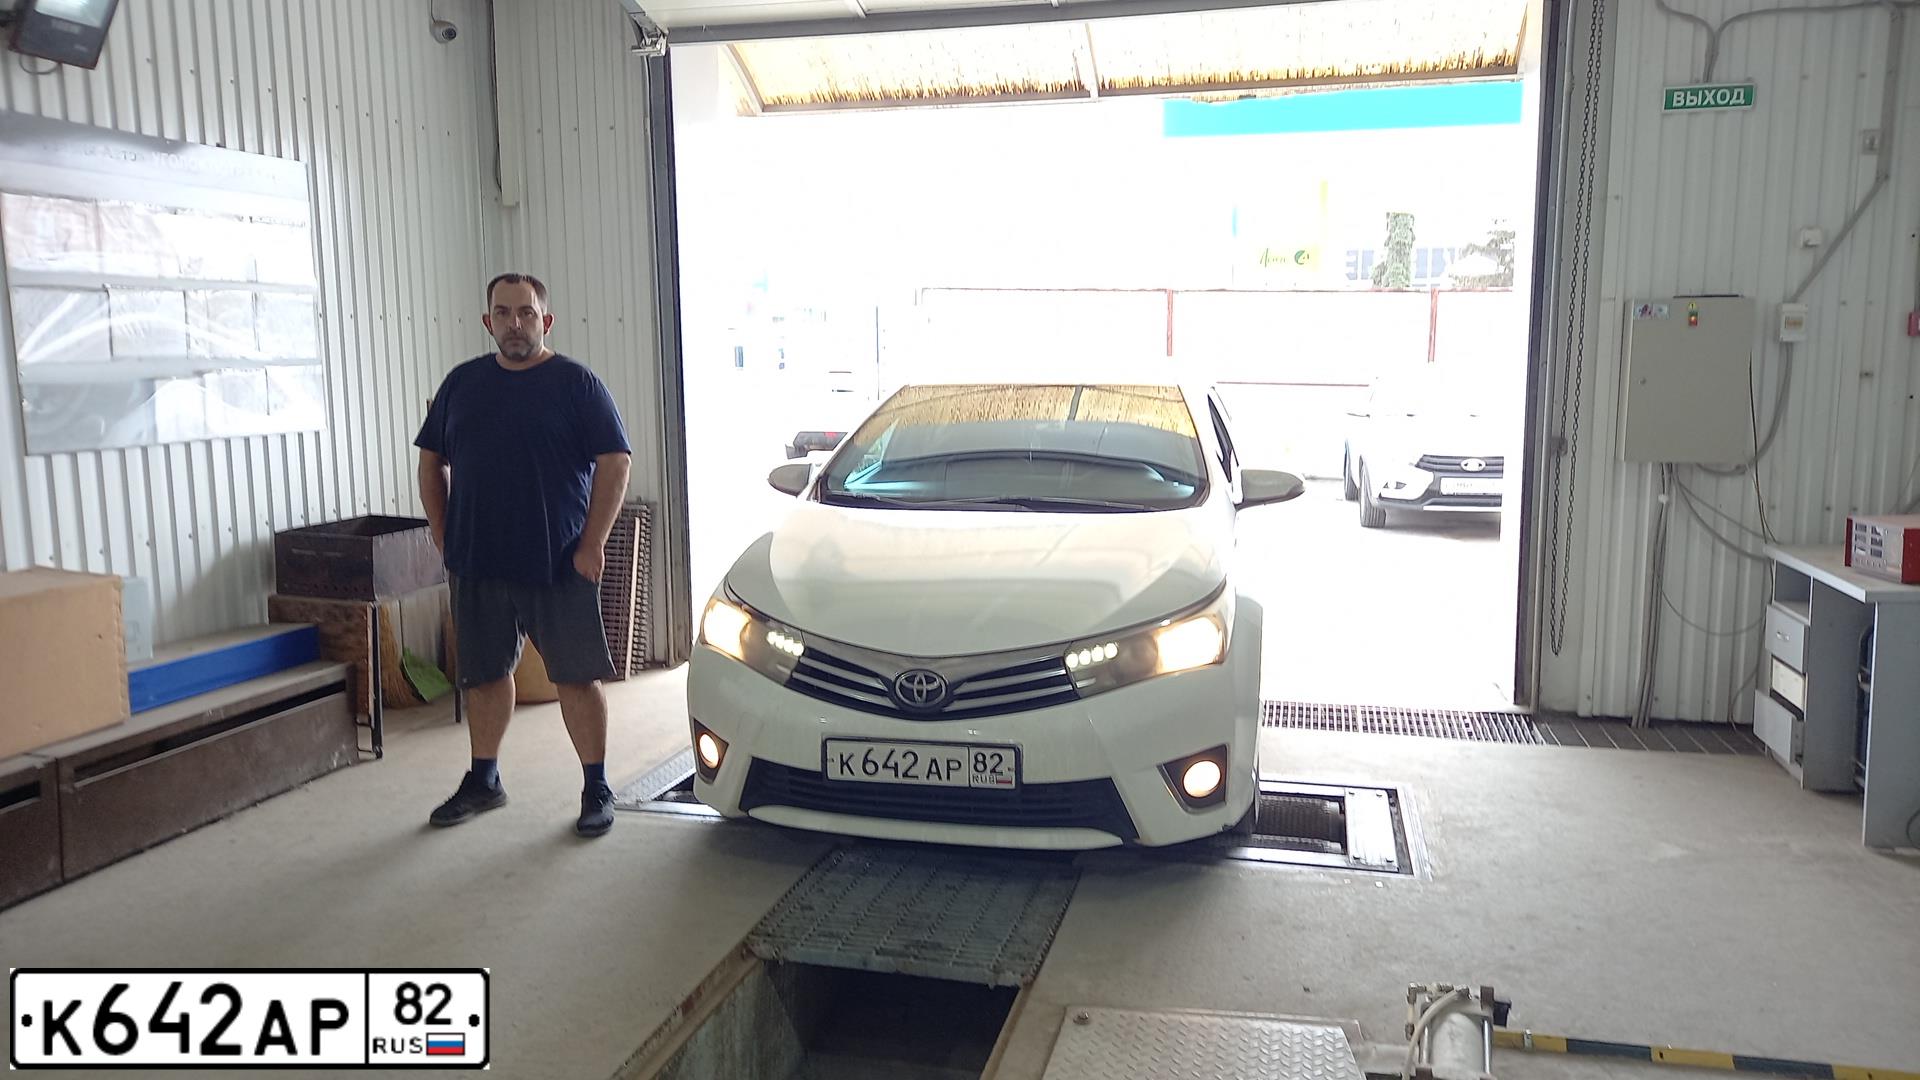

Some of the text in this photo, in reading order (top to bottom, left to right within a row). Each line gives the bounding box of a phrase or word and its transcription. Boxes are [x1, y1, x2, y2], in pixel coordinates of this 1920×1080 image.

[1672, 87, 1745, 108] ВЫХОД
[839, 747, 962, 781] К642АР
[973, 752, 1004, 776] 82
